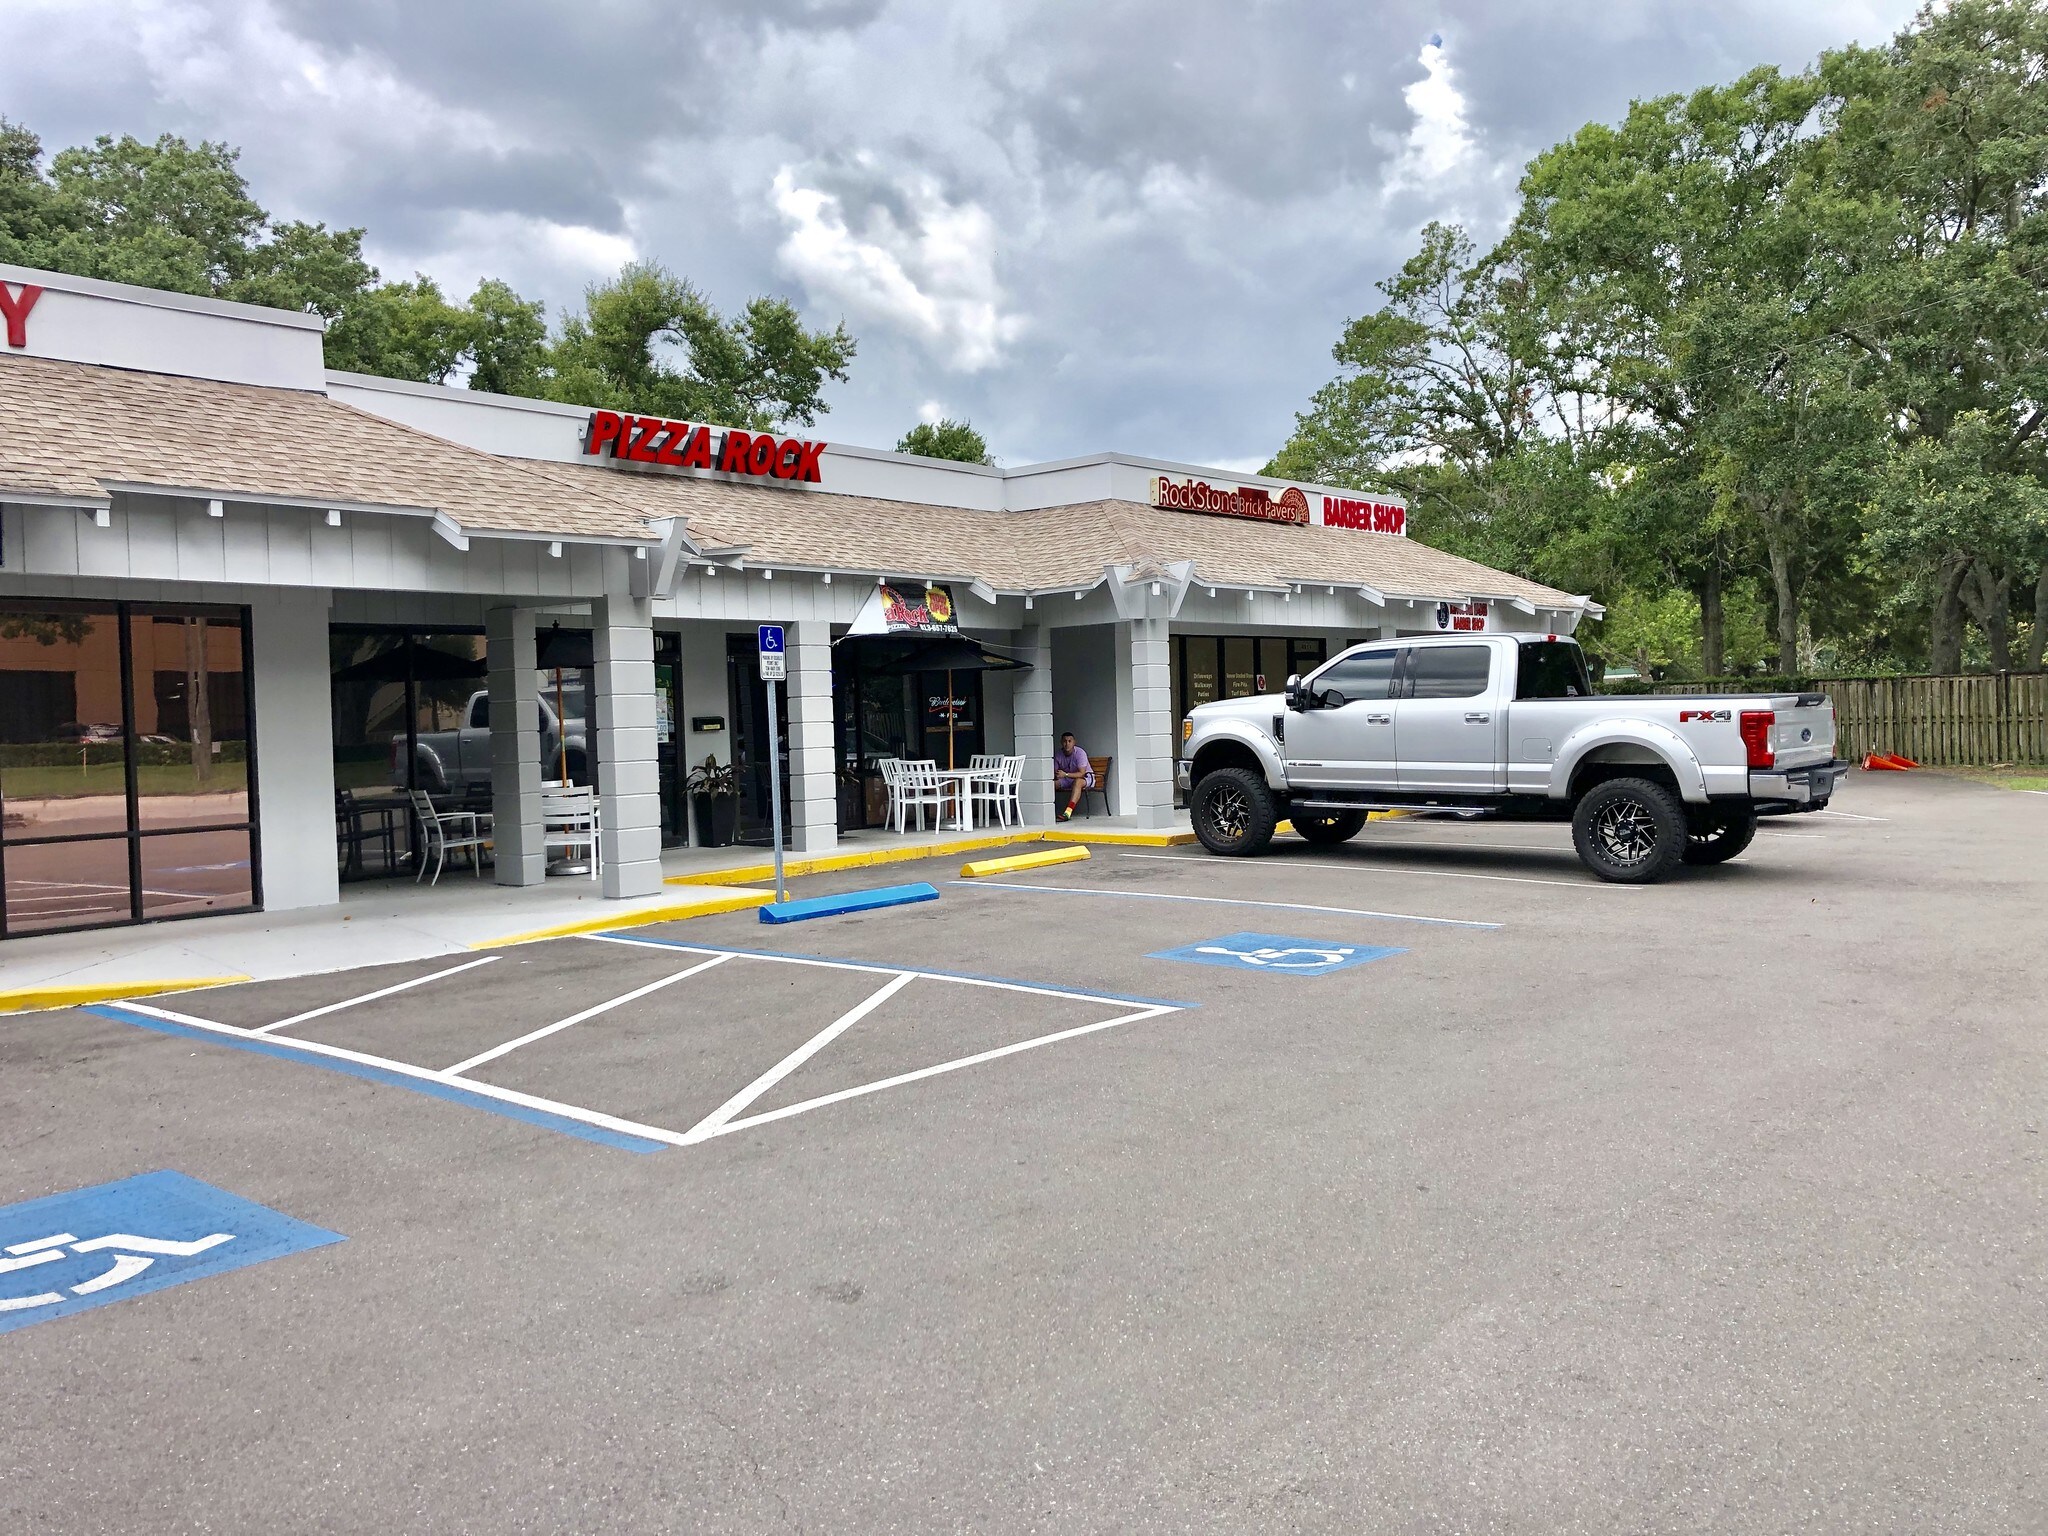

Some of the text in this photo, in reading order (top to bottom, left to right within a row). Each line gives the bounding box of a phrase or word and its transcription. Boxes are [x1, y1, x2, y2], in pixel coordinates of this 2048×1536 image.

[584, 411, 828, 483] PIZZA ROCK
[1159, 476, 1297, 522] RockStone Brick Pavers
[1323, 496, 1405, 535] BARBER SHOP
[1680, 710, 1732, 722] FX4
